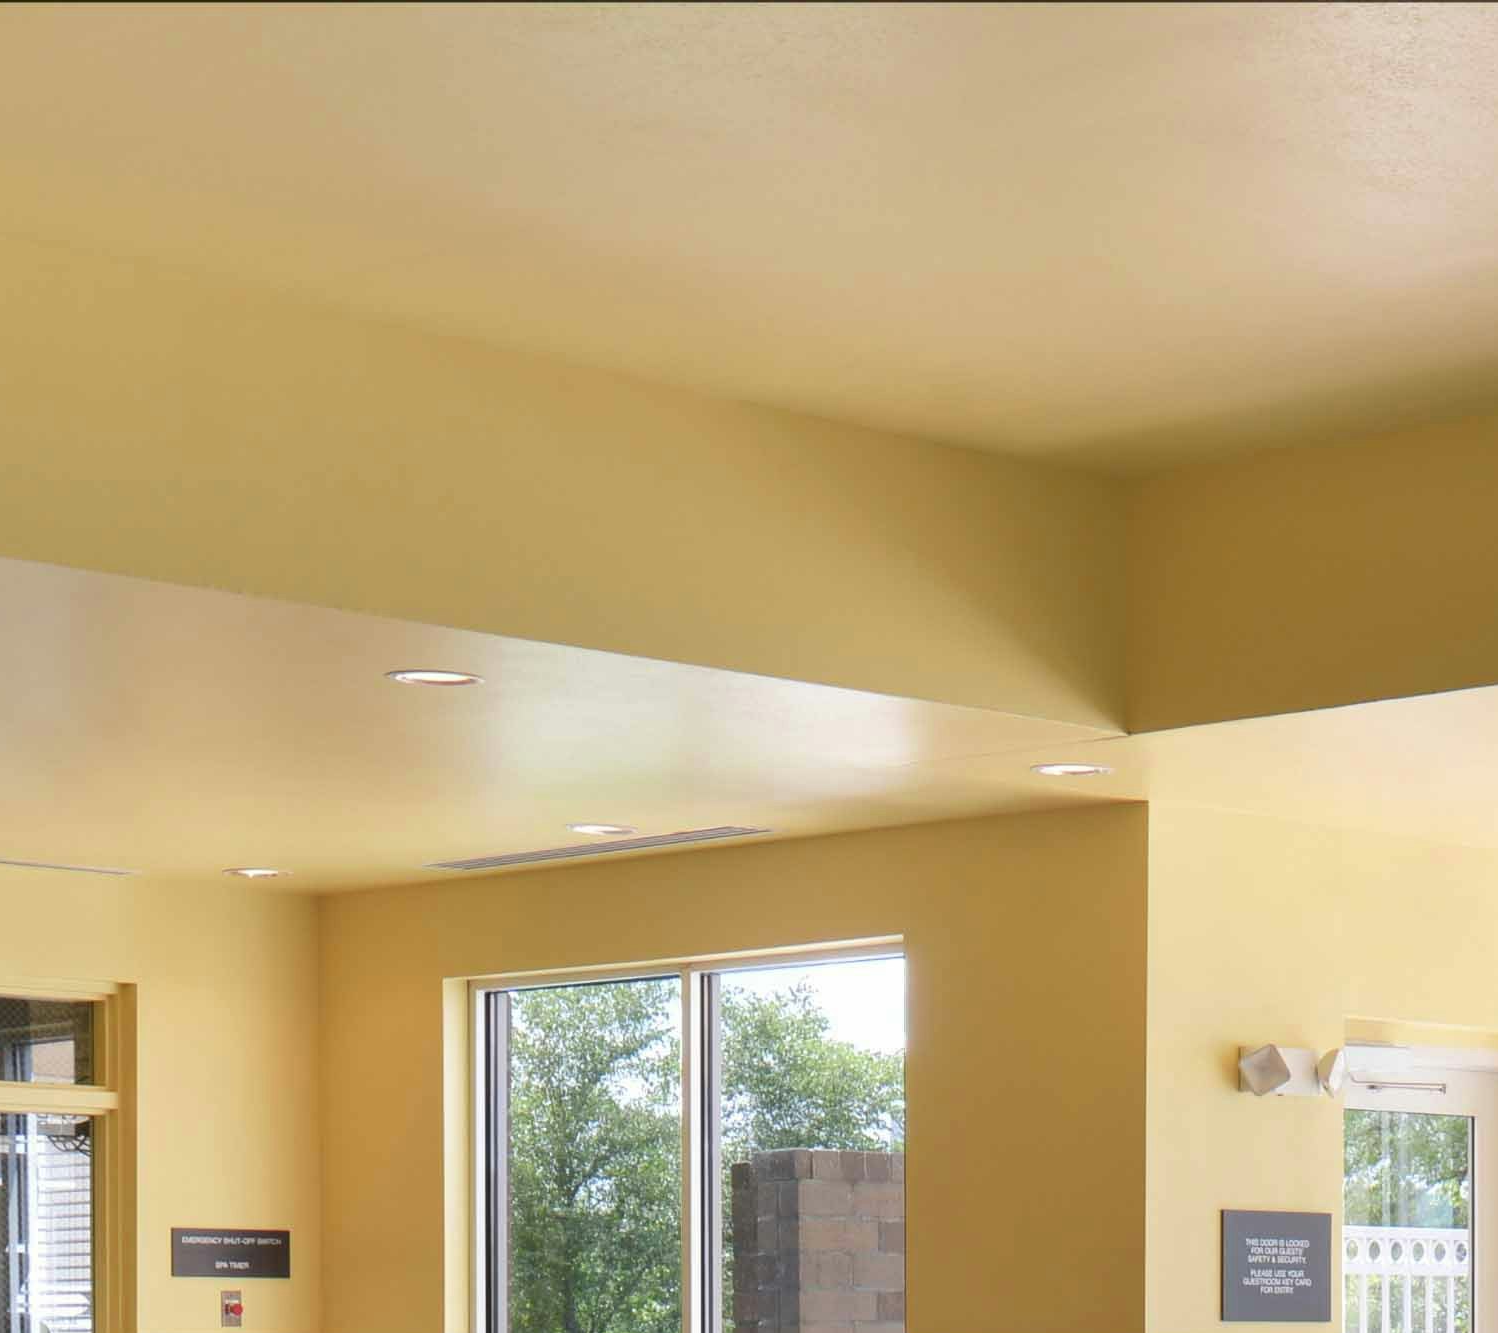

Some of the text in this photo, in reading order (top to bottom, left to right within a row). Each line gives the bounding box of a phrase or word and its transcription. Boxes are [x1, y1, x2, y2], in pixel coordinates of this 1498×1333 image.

[1245, 1238, 1310, 1248] THIS DOOR IS LOCKED
[1250, 1247, 1263, 1255] FOR
[1264, 1247, 1278, 1255] OUR
[1247, 1255, 1270, 1263] SAFETY
[1271, 1255, 1276, 1263] &
[1250, 1269, 1305, 1278] PLEASE USE YOUR
[1281, 1278, 1294, 1286] KEY
[1294, 1278, 1312, 1286] CARD
[1260, 1286, 1273, 1294] FOR
